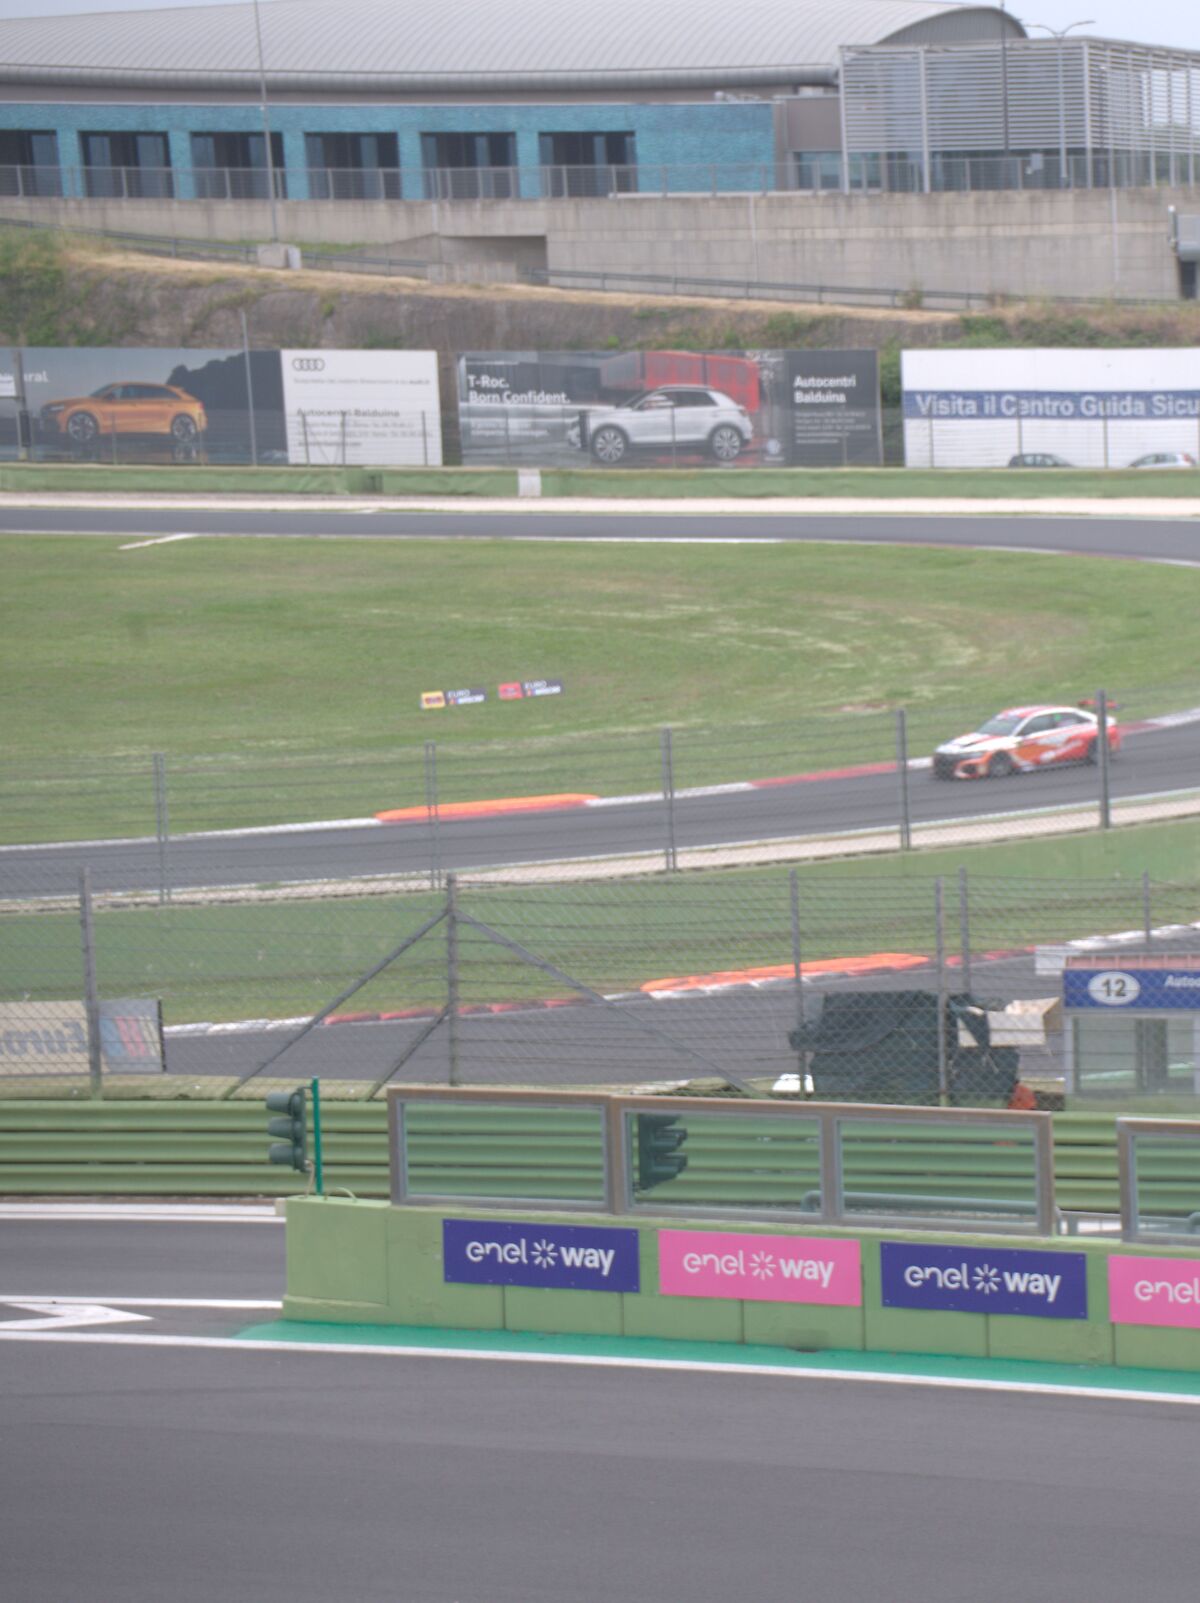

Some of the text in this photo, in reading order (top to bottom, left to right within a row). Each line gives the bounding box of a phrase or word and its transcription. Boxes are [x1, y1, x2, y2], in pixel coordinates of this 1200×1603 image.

[794, 374, 857, 388] Autocentri
[469, 390, 571, 405] Born Confident.
[794, 389, 847, 403] Balduina
[915, 394, 978, 416] Visita
[983, 395, 997, 415] il
[1000, 394, 1074, 416] Centro
[1080, 395, 1146, 416] Guida
[1101, 979, 1127, 998] 12
[466, 1238, 616, 1276] enel way
[682, 1250, 834, 1288] enel way
[904, 1262, 1061, 1303] enel way
[1134, 1277, 1200, 1304] enel
